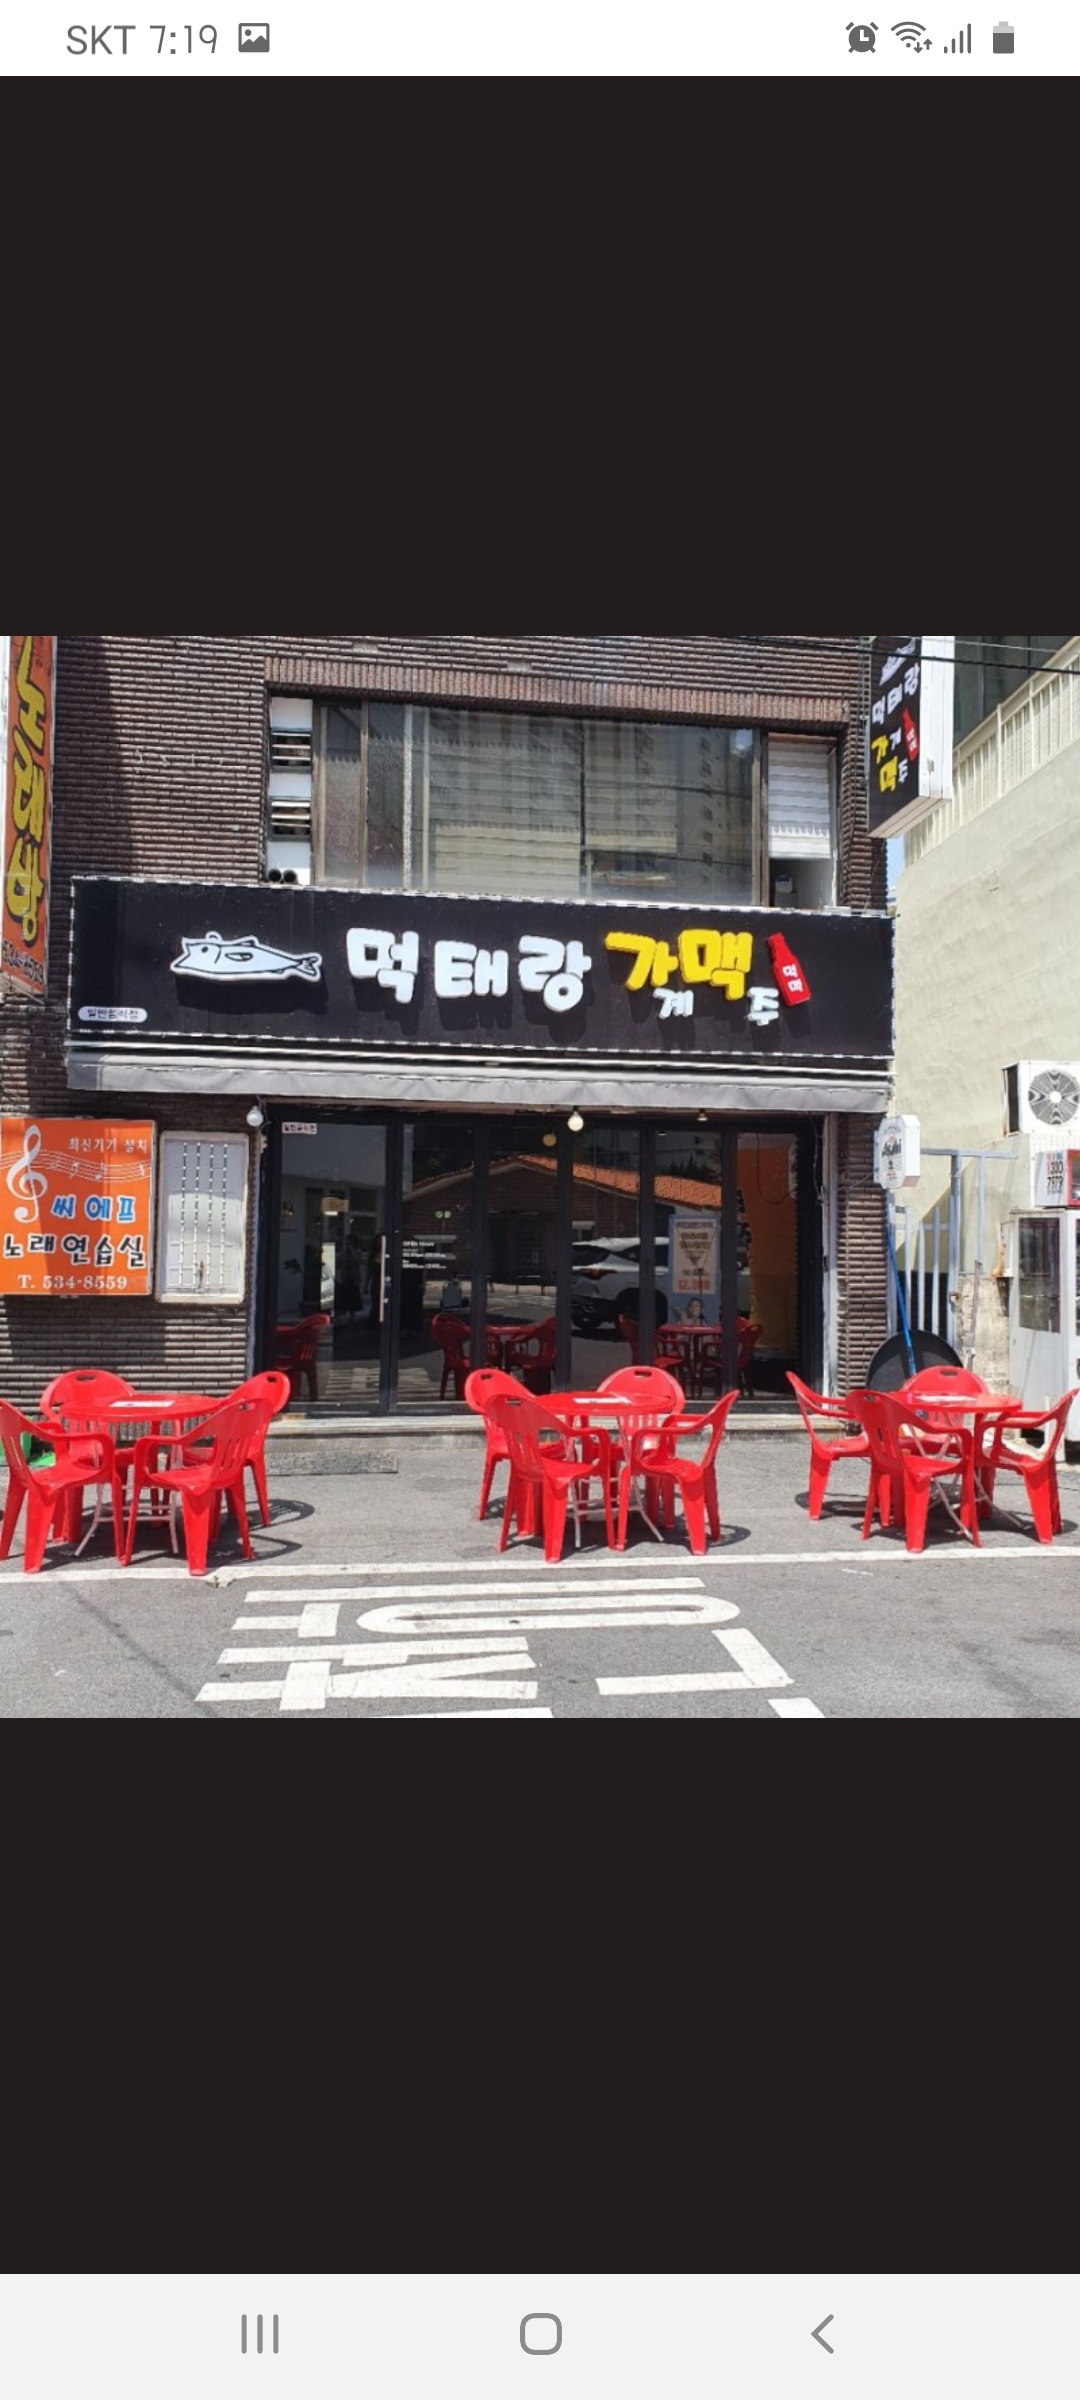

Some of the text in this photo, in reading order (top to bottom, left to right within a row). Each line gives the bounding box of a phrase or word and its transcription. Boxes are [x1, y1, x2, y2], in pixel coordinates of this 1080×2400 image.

[346, 927, 593, 1013] 먹태랑
[69, 1137, 147, 1154] 최신기기 설치
[4, 1232, 147, 1270] 노래연습실
[17, 1274, 128, 1290] T. 534-8559
